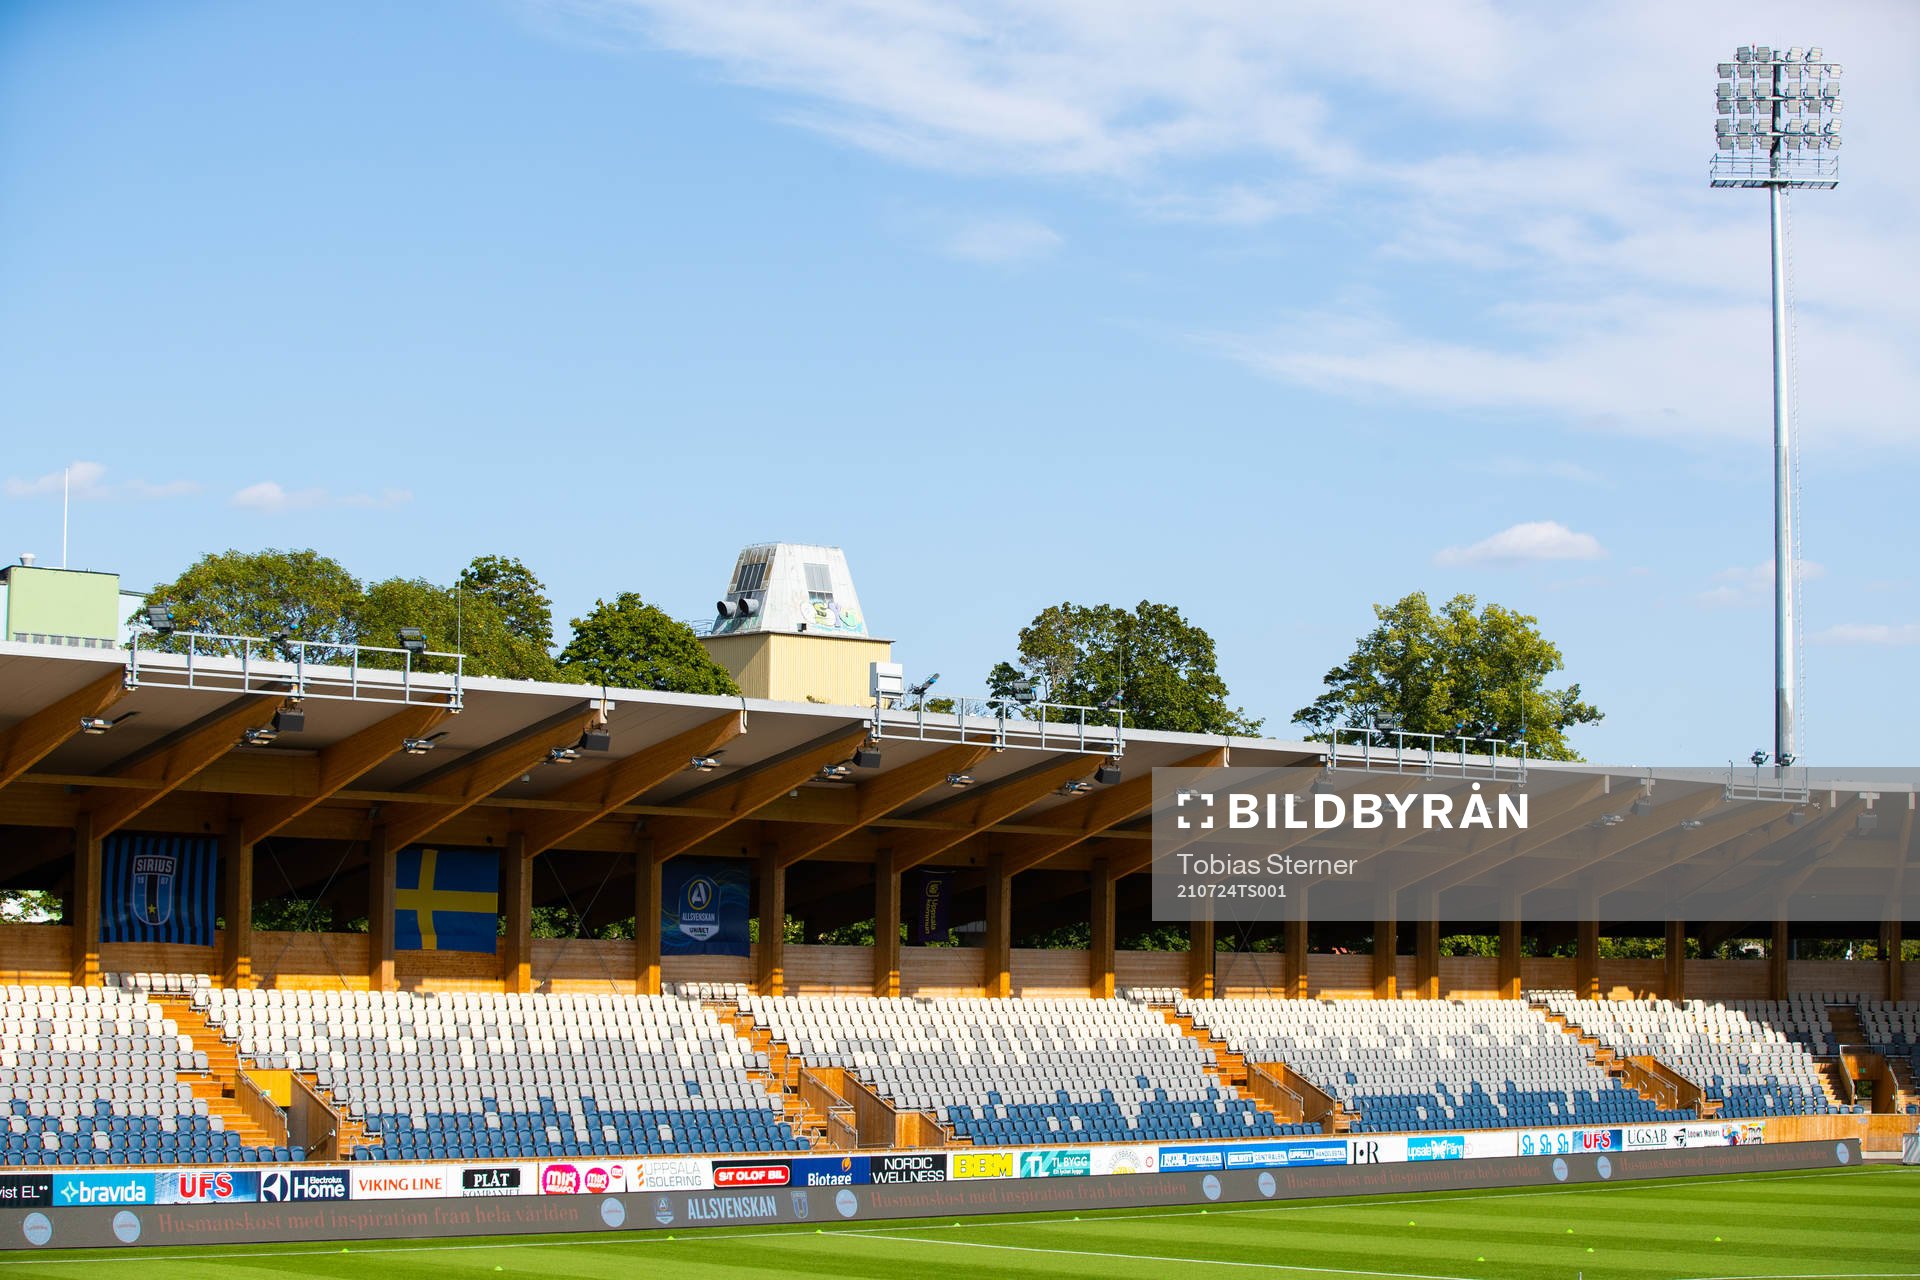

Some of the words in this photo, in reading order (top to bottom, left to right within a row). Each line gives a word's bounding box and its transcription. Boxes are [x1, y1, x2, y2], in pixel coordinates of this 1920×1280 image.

[137, 859, 172, 873] SIRIUS
[1583, 1132, 1611, 1149] UFS
[1627, 1128, 1667, 1144] UGSAB
[644, 1161, 701, 1176] UPPSALA
[884, 1157, 933, 1171] NORDIC
[953, 1153, 1013, 1178] BBM
[1051, 1157, 1063, 1168] TL
[1063, 1156, 1088, 1167] BYGG
[310, 1176, 343, 1185] Electrolux
[473, 1169, 510, 1188] PLÅT
[645, 1175, 702, 1188] ISOLERING
[735, 1170, 766, 1181] OLOF
[767, 1170, 786, 1180] BIL
[807, 1172, 853, 1187] Biotage
[872, 1170, 945, 1184] WELLNESS
[80, 1180, 147, 1203] bravida
[179, 1174, 233, 1199] UFS
[294, 1176, 346, 1199] Home
[359, 1178, 410, 1192] VIKING
[412, 1177, 443, 1191] LINE
[22, 1186, 40, 1199] EL
[687, 1195, 778, 1220] ALLSVENSKAN
[158, 1211, 282, 1234] Husmanskost
[287, 1210, 325, 1230] med
[331, 1207, 429, 1231] inspiration
[434, 1206, 471, 1225] från
[474, 1204, 512, 1224] hela
[516, 1203, 579, 1223] världen
